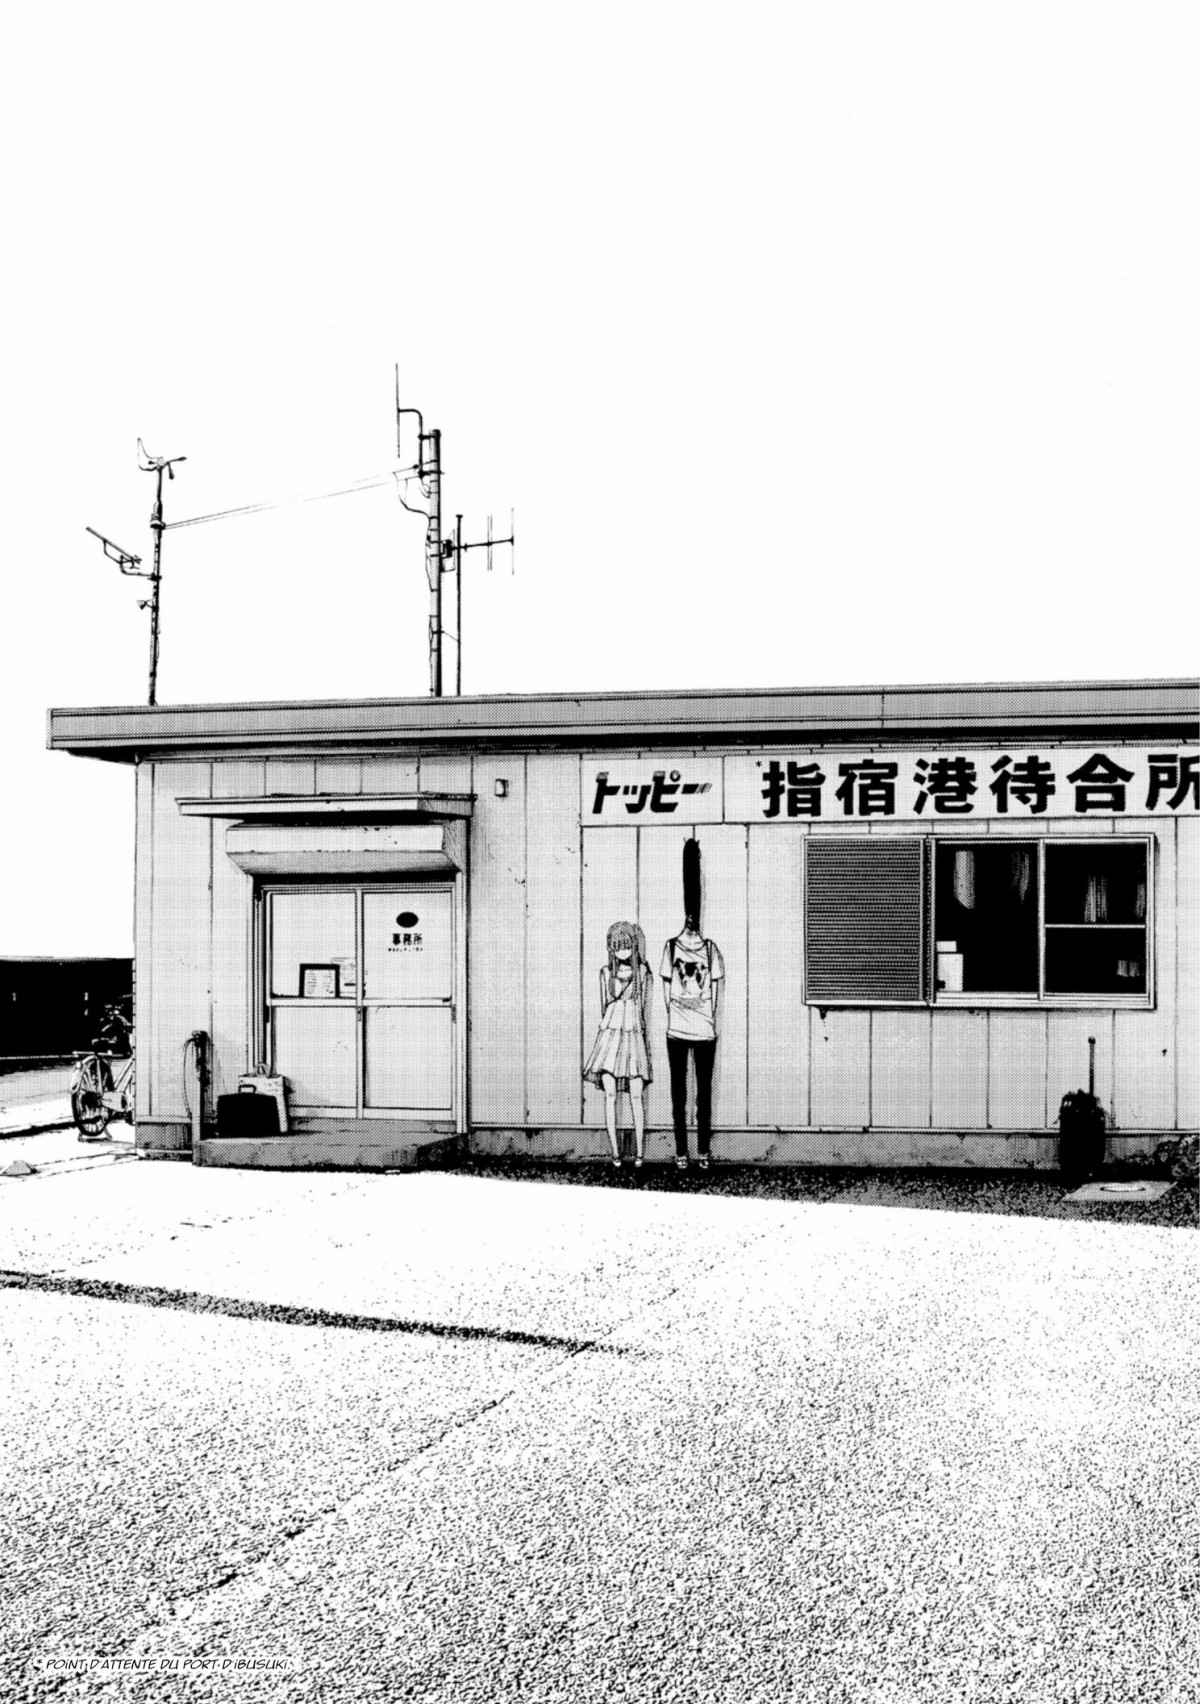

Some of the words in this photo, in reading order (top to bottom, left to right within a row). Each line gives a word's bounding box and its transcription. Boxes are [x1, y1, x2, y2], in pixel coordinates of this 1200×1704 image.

[592, 769, 712, 814] トッピー
[761, 753, 1200, 818] 指宿港待合所
